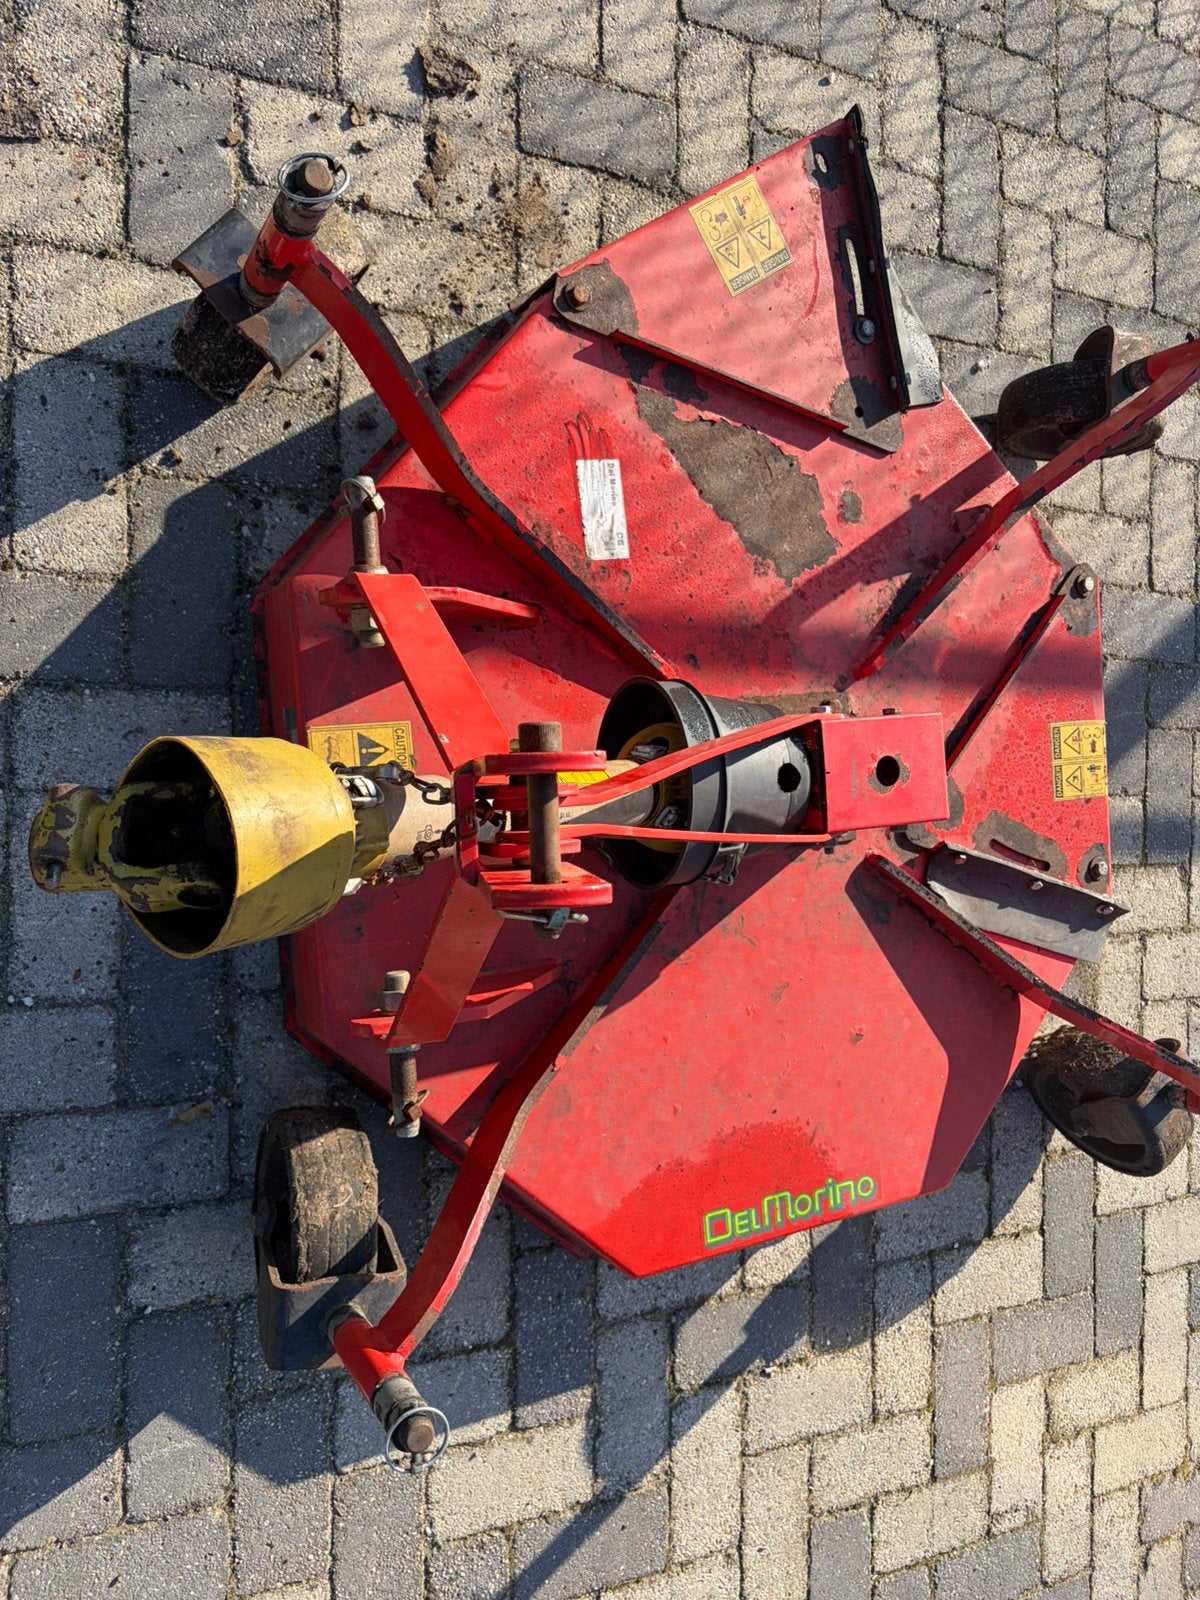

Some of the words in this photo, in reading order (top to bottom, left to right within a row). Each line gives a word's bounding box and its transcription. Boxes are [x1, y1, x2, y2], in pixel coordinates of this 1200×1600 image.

[763, 250, 790, 271] DANGER
[731, 269, 760, 291] DANGER
[609, 478, 619, 507] Morino
[616, 532, 625, 547] CE
[1053, 727, 1061, 759] DANGER
[1054, 766, 1063, 797] DANGER
